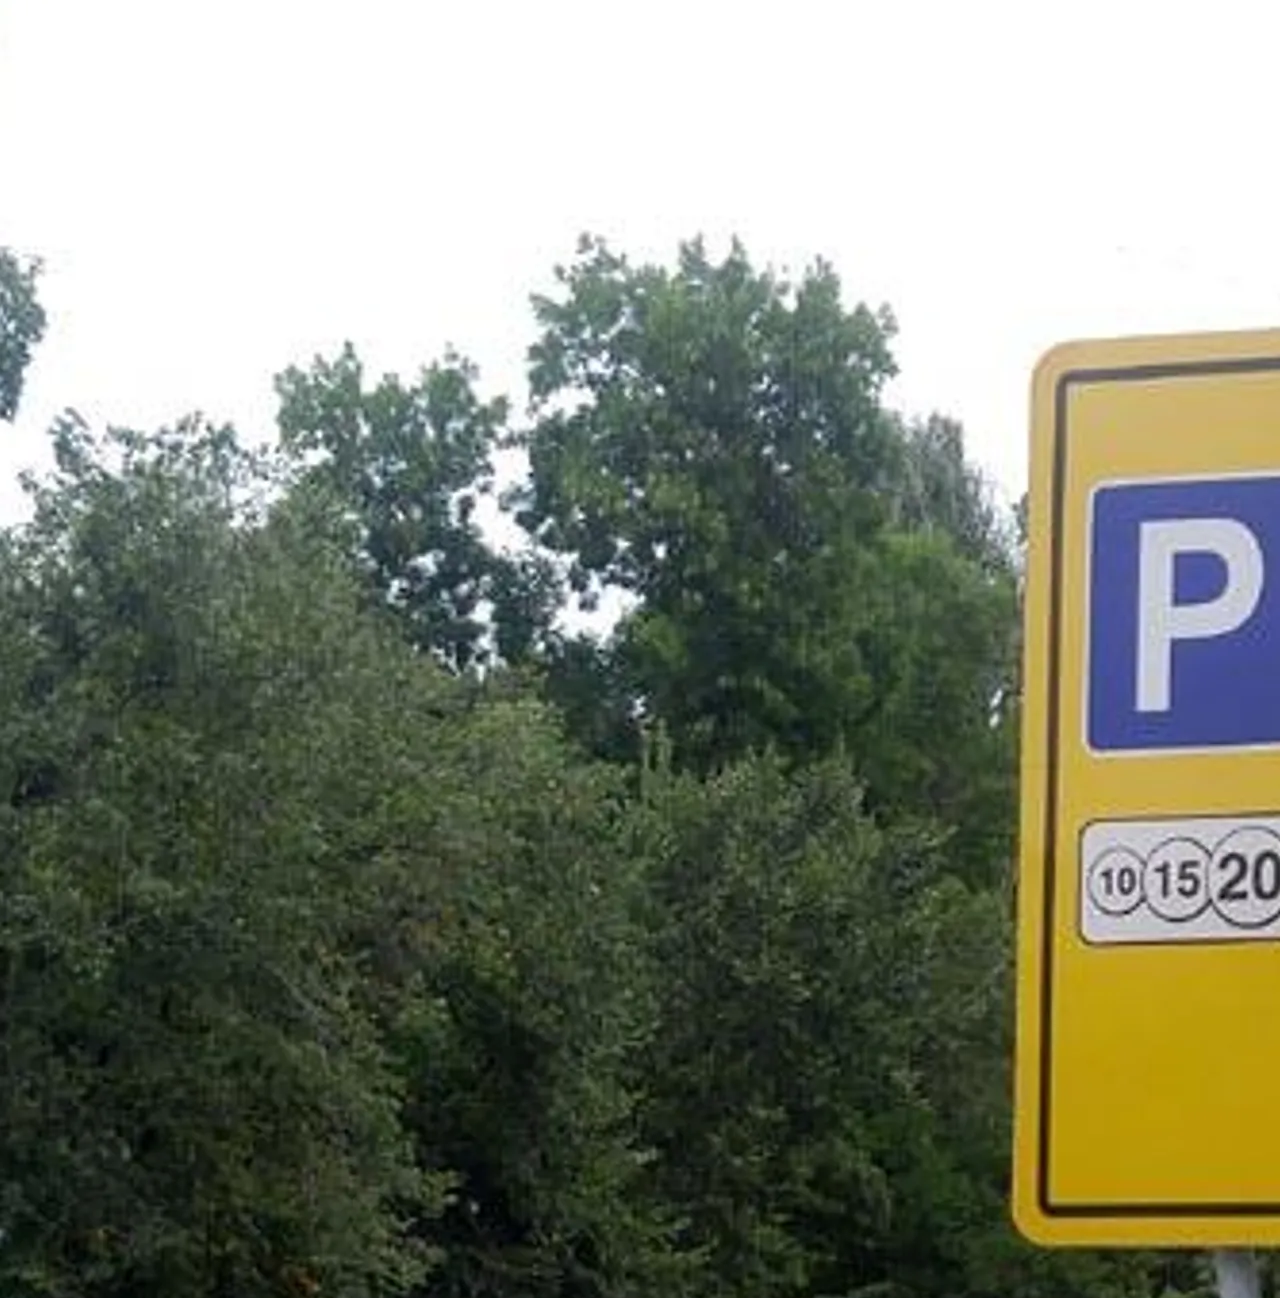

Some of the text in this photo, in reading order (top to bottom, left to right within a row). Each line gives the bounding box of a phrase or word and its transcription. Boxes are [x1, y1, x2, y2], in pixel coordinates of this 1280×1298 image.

[1136, 517, 1265, 713] P
[1100, 867, 1137, 897] 10
[1154, 860, 1202, 899] 15
